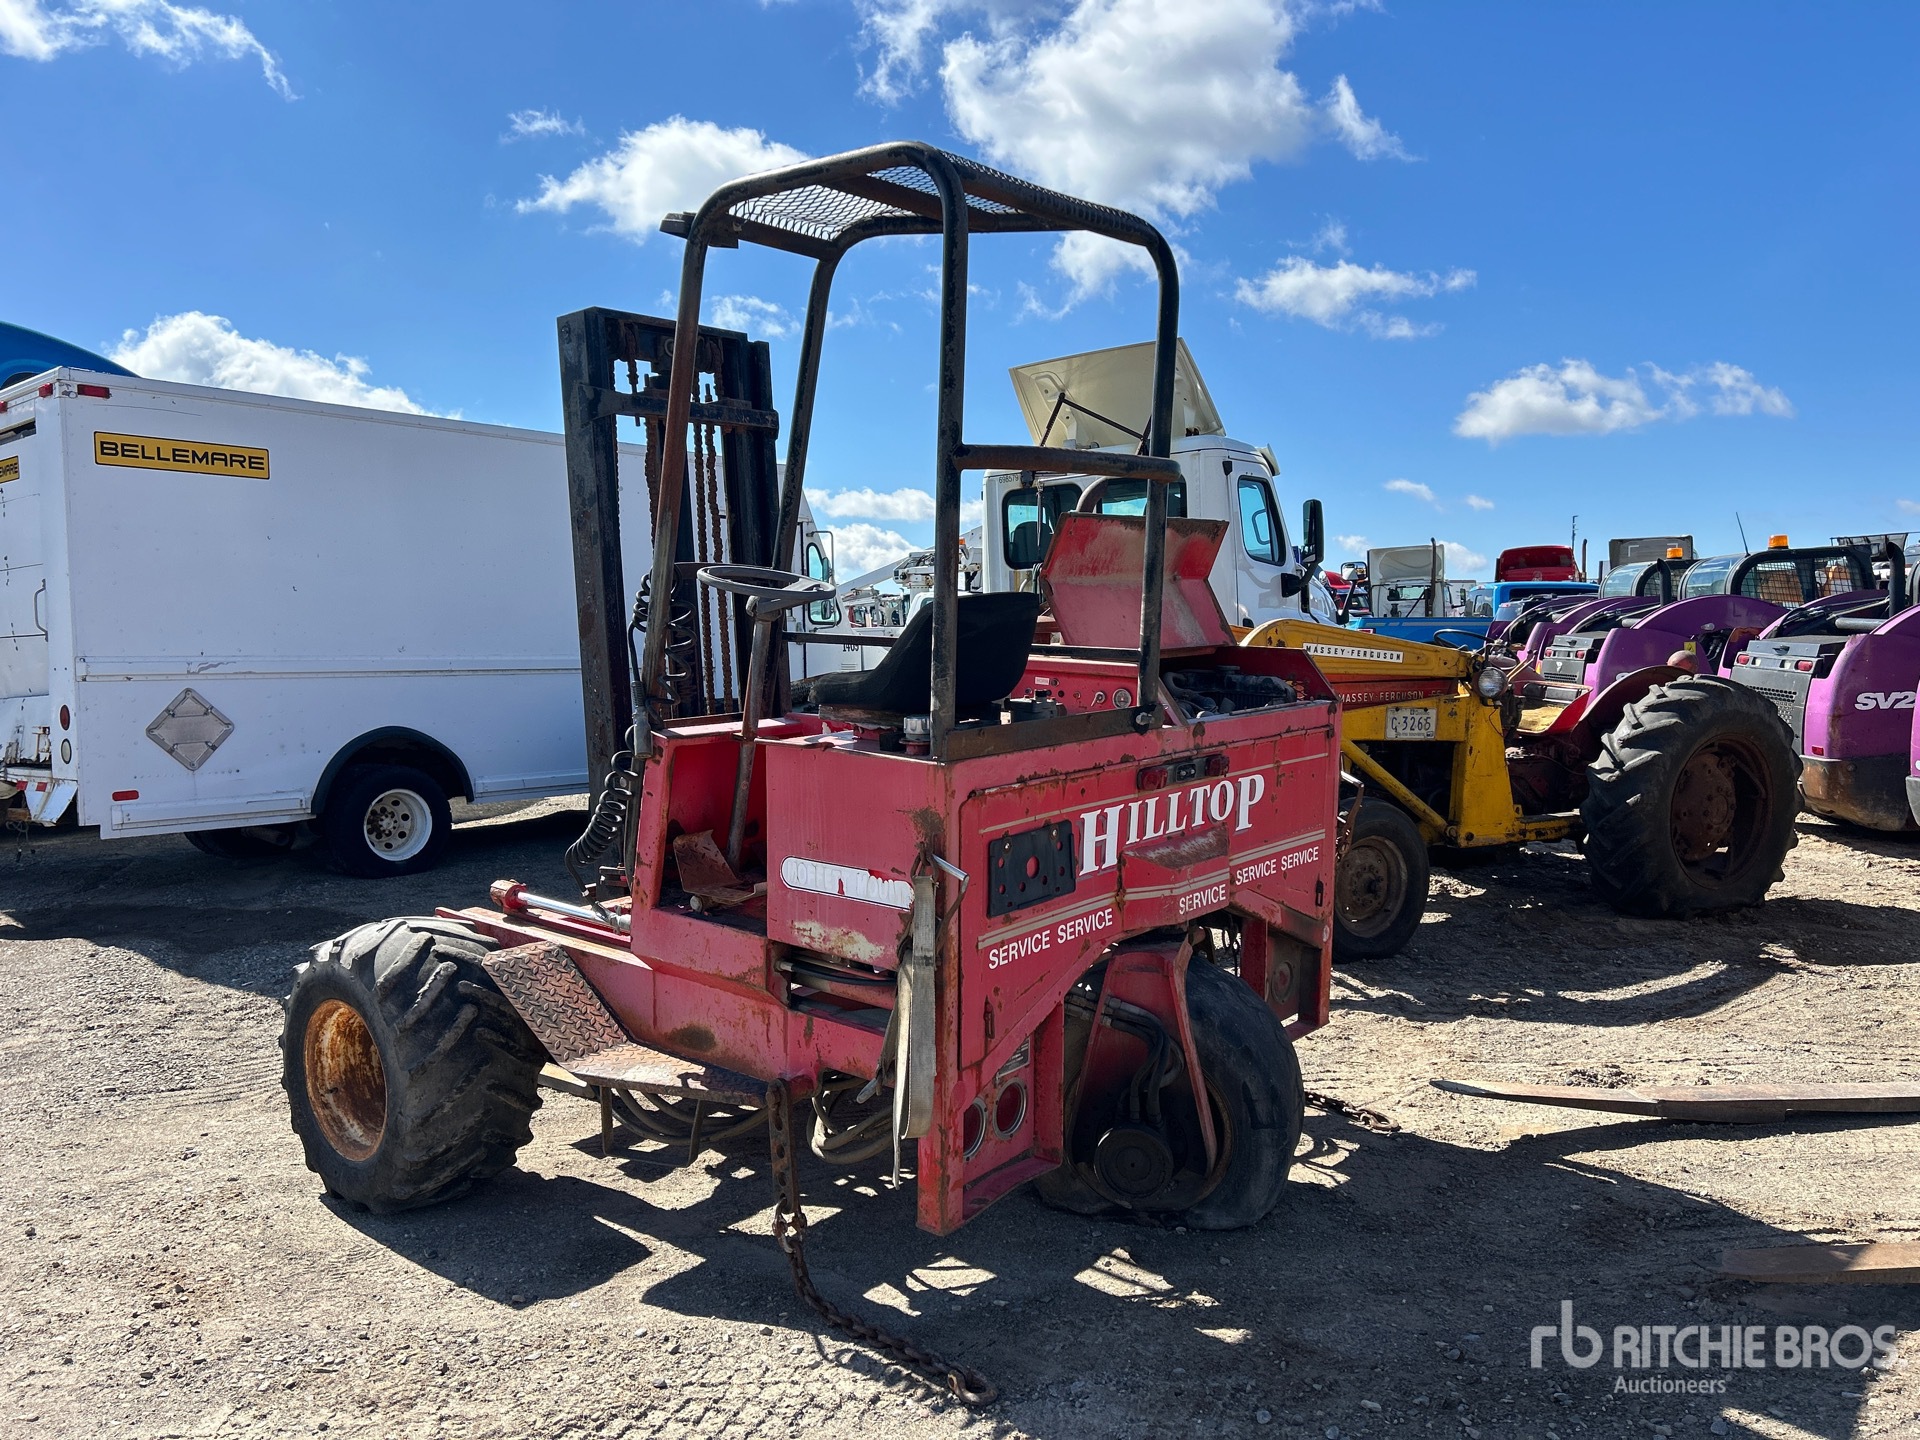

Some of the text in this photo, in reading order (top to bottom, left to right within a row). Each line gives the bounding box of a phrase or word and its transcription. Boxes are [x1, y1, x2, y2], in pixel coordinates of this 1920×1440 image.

[99, 440, 266, 471] BELLEMARE
[998, 474, 1019, 484] 698579
[1078, 773, 1266, 877] HILLTOP
[988, 846, 1320, 970] SERVICE SERVICE SERVICE SERVICE SERVICE
